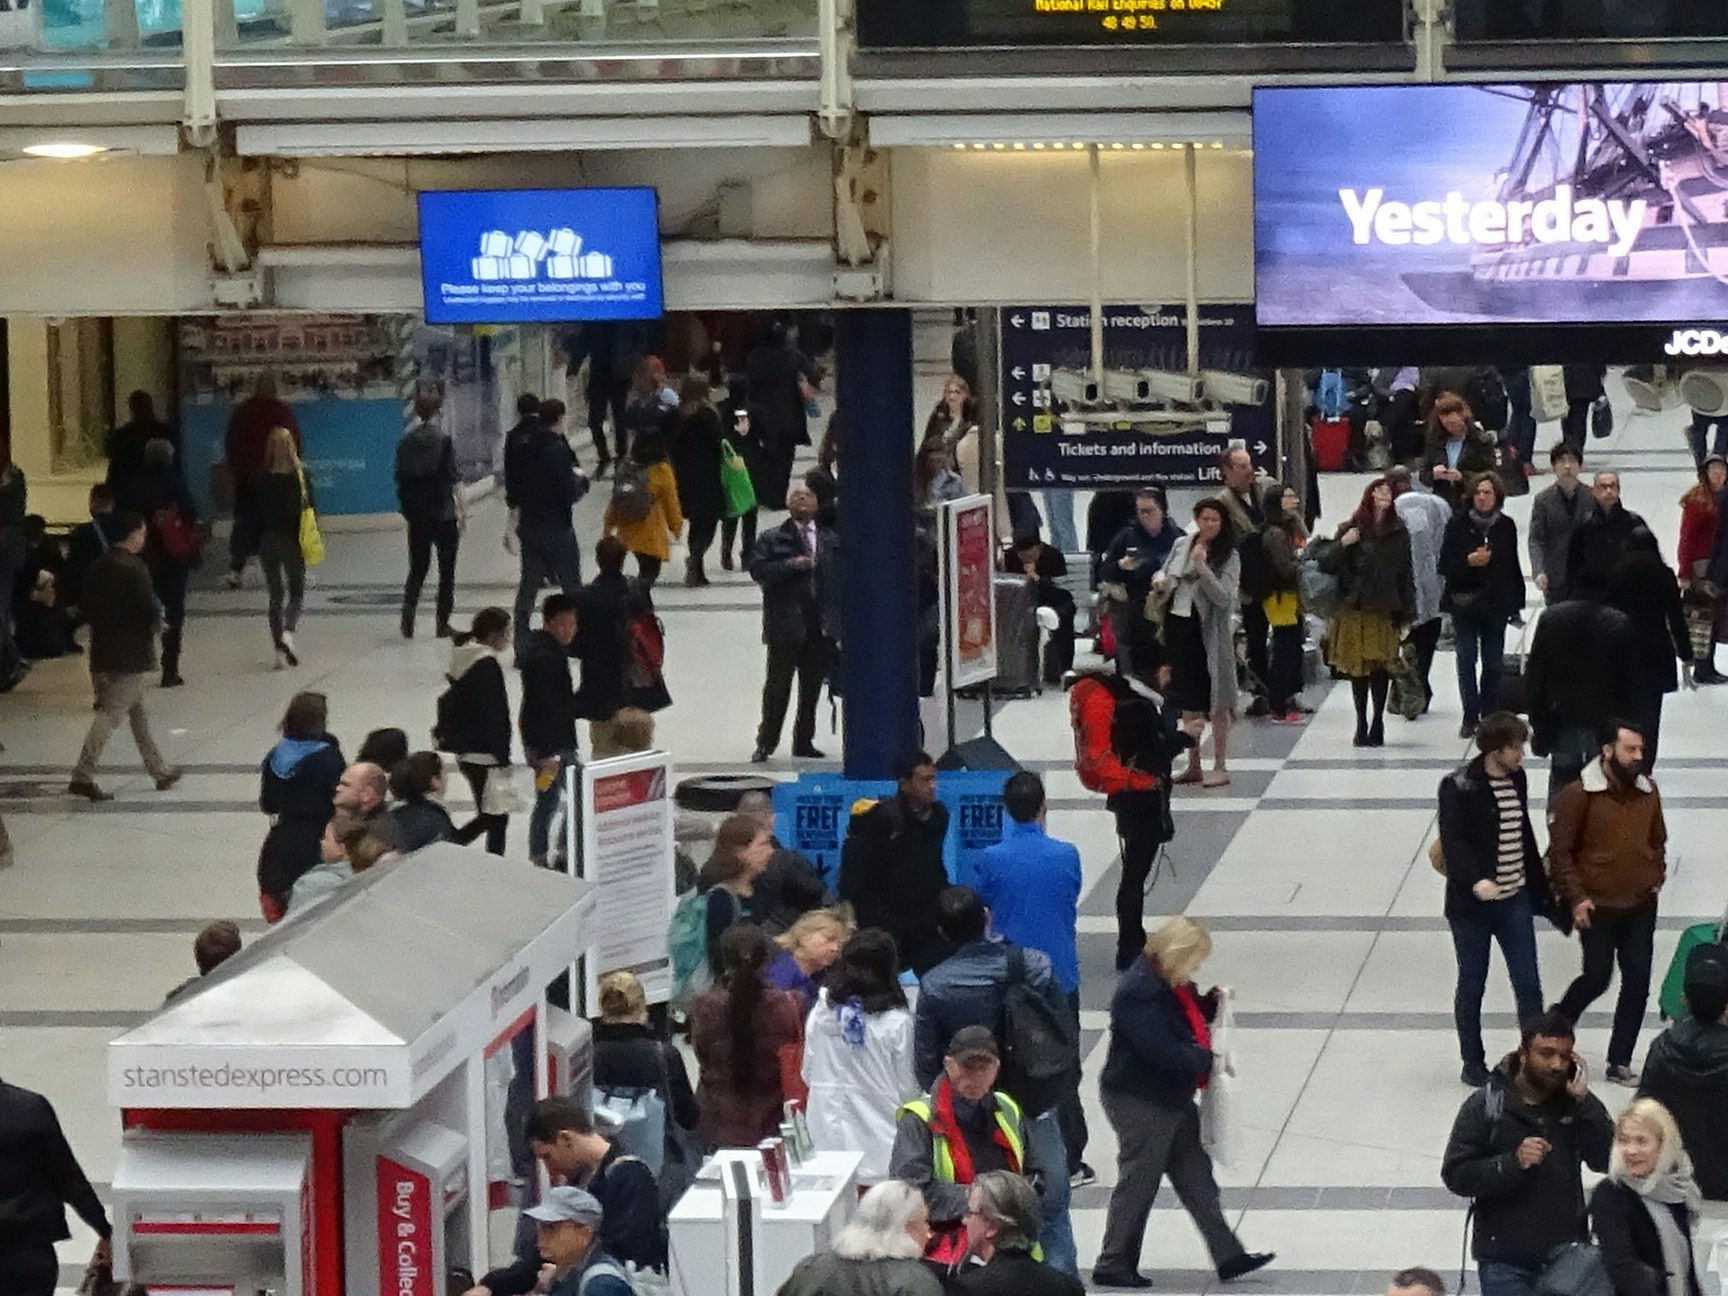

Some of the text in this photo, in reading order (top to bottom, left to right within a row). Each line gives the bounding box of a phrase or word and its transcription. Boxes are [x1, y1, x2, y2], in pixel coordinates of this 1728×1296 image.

[1339, 187, 1647, 257] Yesterday
[440, 282, 479, 294] Please
[481, 282, 509, 295] keep
[511, 284, 536, 295] your
[537, 281, 598, 294] belongings
[1056, 313, 1108, 328] Statin
[1110, 312, 1179, 330] reception
[1058, 441, 1221, 457] Tickets and information
[123, 1062, 388, 1092] stanstedexpress.com
[392, 1180, 415, 1219] Buy
[397, 1222, 414, 1238] &
